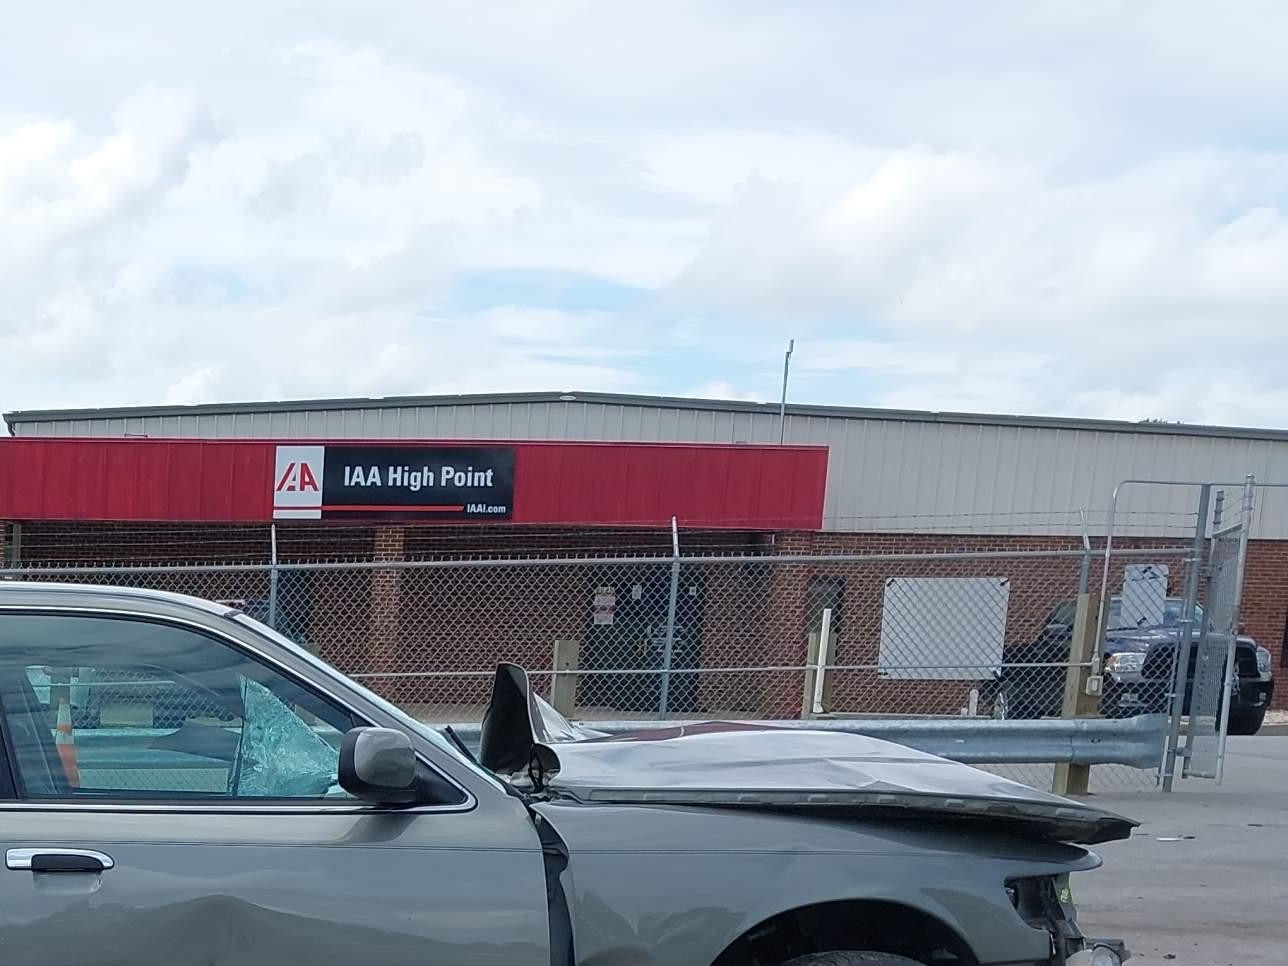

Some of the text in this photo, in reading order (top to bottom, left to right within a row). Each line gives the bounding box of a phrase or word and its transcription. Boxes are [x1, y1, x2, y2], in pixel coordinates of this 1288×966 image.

[343, 466, 494, 492] IAA High Point
[466, 503, 507, 514] IAAI.com
